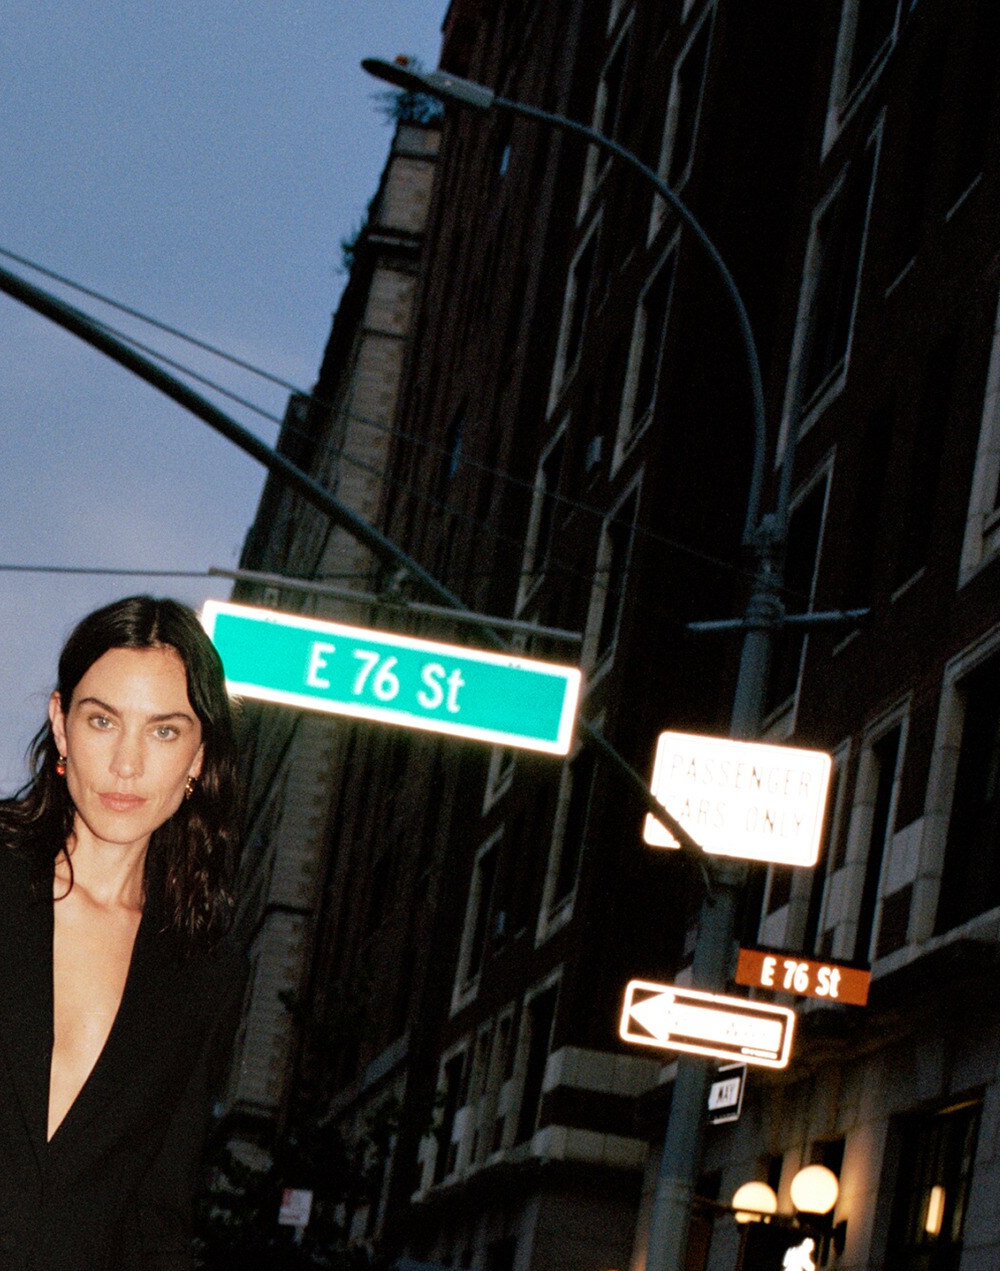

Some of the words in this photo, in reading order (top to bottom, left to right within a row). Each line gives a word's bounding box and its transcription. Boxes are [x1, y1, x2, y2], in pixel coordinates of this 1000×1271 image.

[306, 641, 336, 689] E
[353, 648, 400, 702] 76
[417, 662, 466, 714] St
[670, 753, 813, 798] PASSENGER
[744, 804, 808, 840] ONLY
[759, 956, 777, 987] E
[782, 960, 809, 992] 76
[814, 966, 841, 998] St
